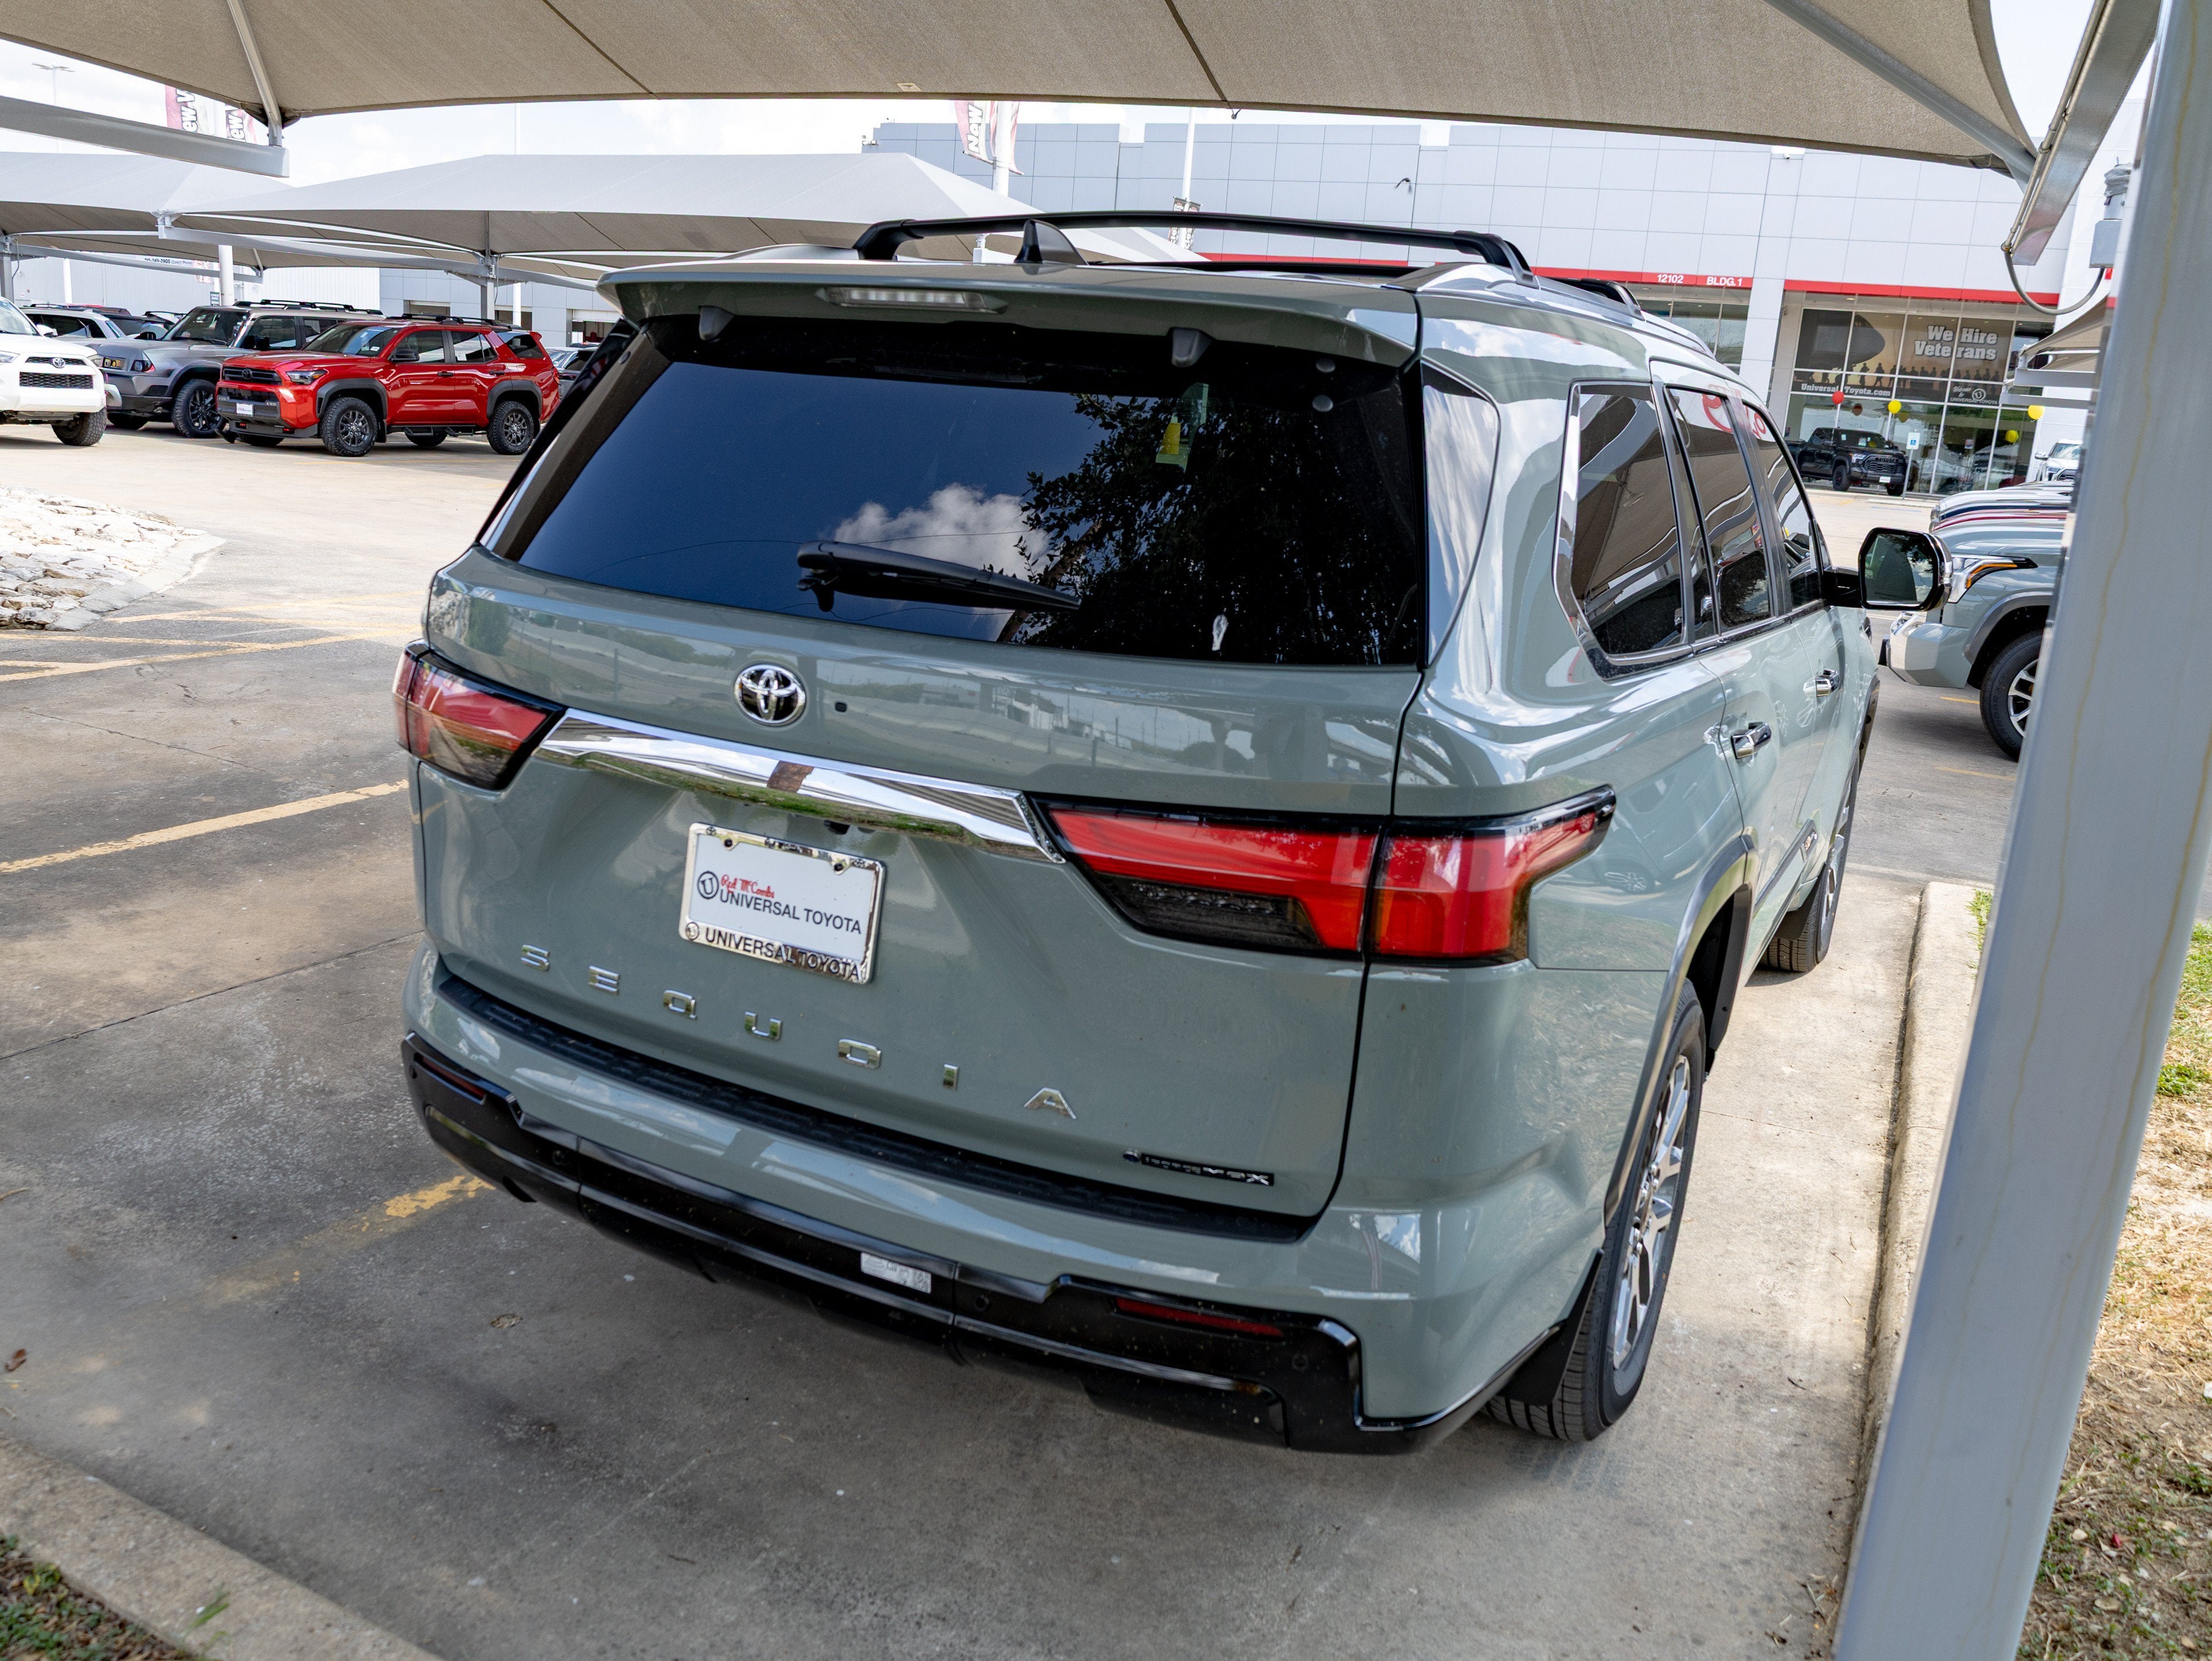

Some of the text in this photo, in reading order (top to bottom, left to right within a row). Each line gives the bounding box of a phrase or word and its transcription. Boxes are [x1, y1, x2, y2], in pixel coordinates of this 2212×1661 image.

[181, 105, 198, 133] ew
[967, 104, 983, 154] New
[1657, 274, 1743, 286] 12102 BLDG. 1
[1927, 325, 1998, 345] We Hire
[720, 890, 862, 934] UNIVERSAL TOYOTA
[706, 927, 796, 964] UNIVERSAL
[797, 948, 862, 980] TOYOTA
[520, 944, 1077, 1120] SEQUOIA
